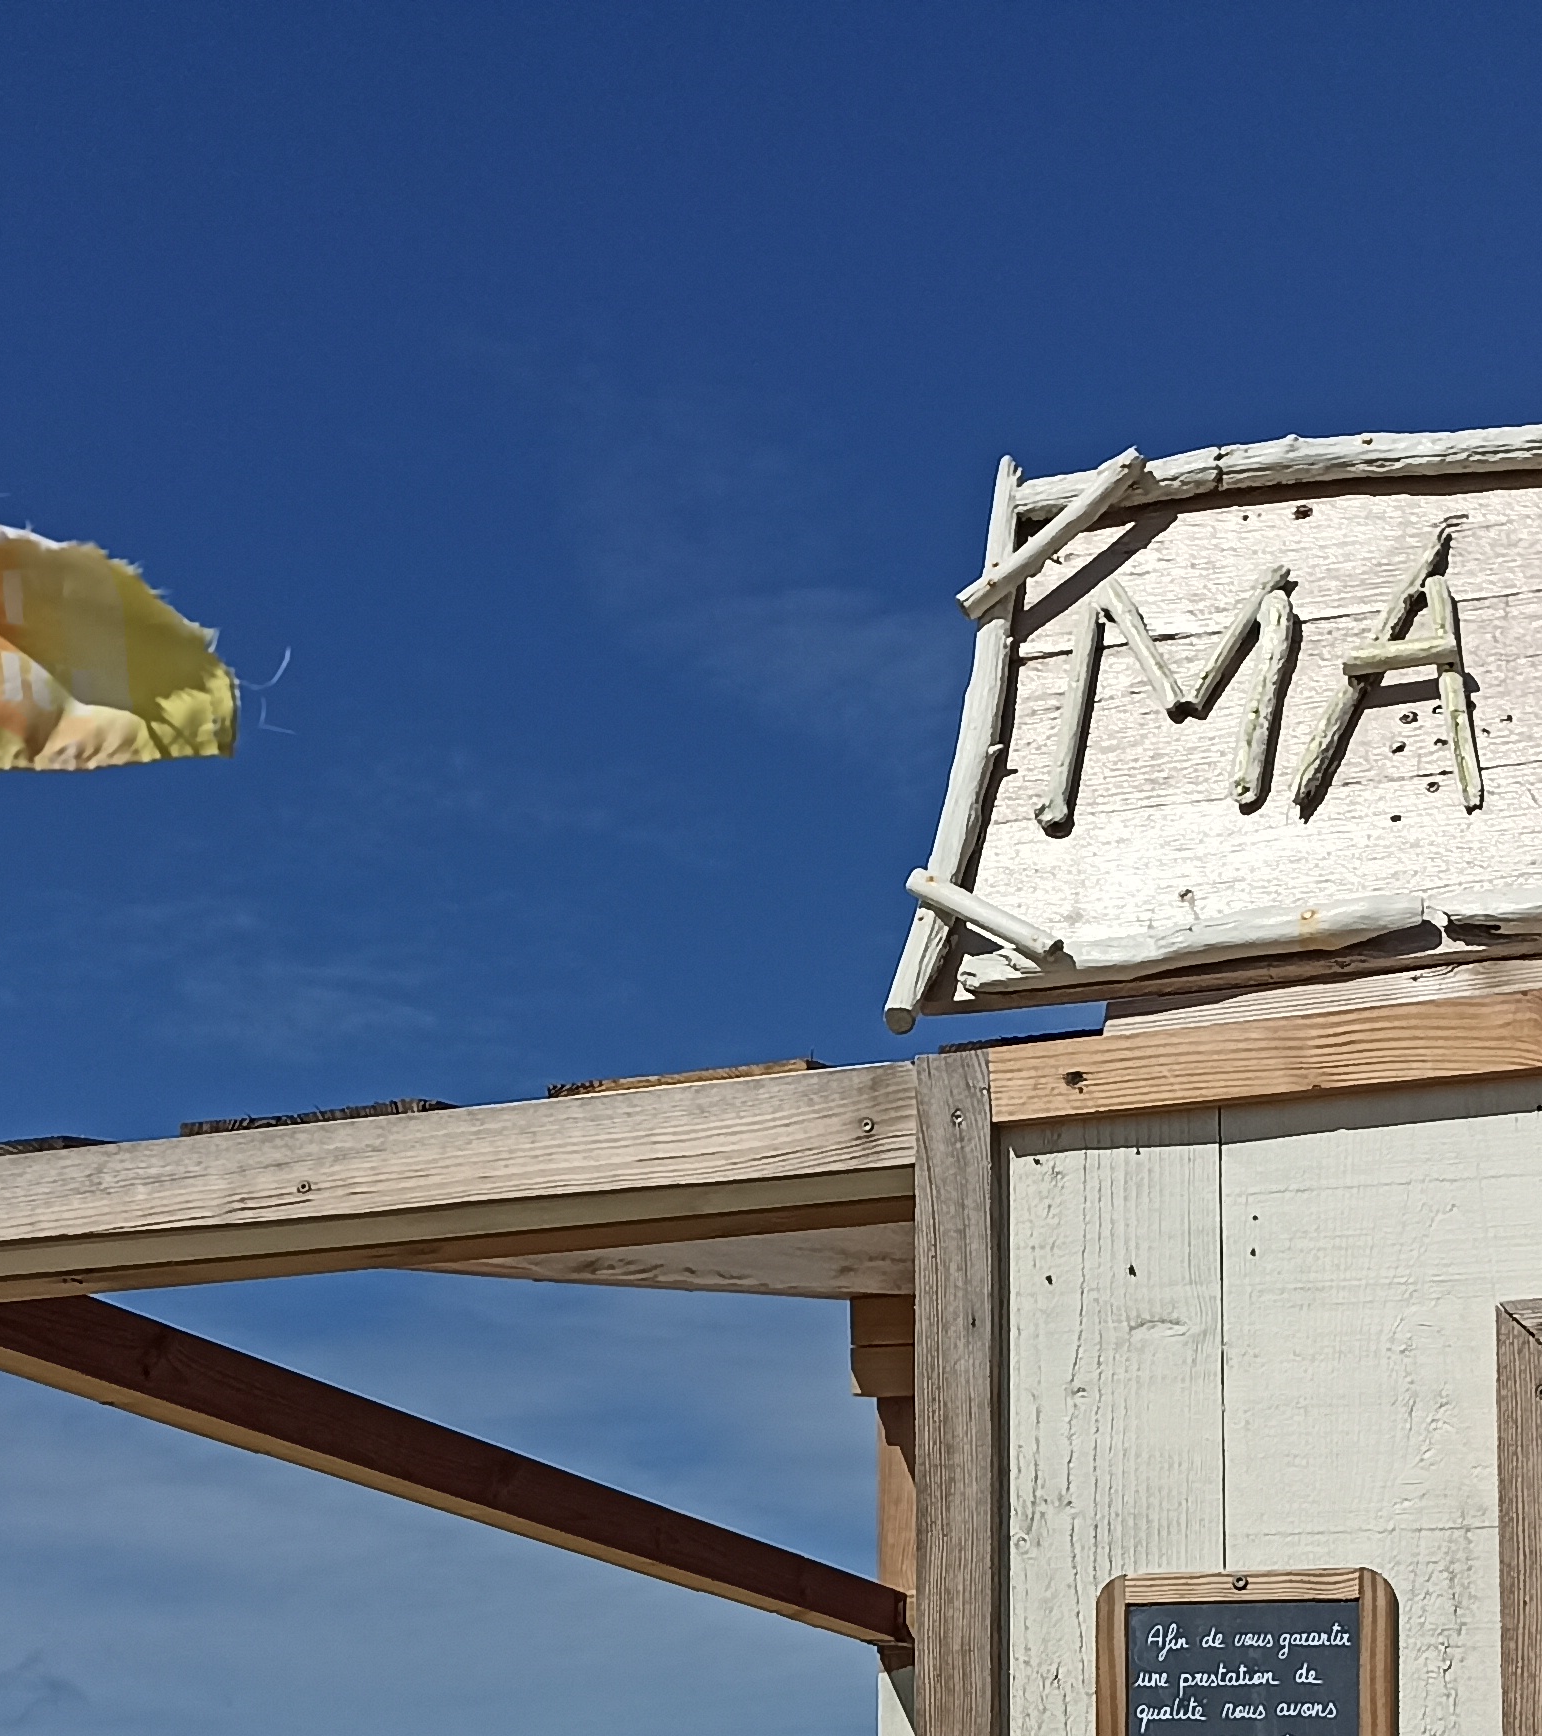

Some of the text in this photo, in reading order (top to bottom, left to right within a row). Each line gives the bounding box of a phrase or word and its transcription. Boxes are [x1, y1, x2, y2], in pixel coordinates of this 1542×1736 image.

[1147, 1623, 1351, 1661] Afin de vous garantir
[1133, 1662, 1324, 1698] une prestation de
[1136, 1697, 1337, 1733] qualité nous avons
